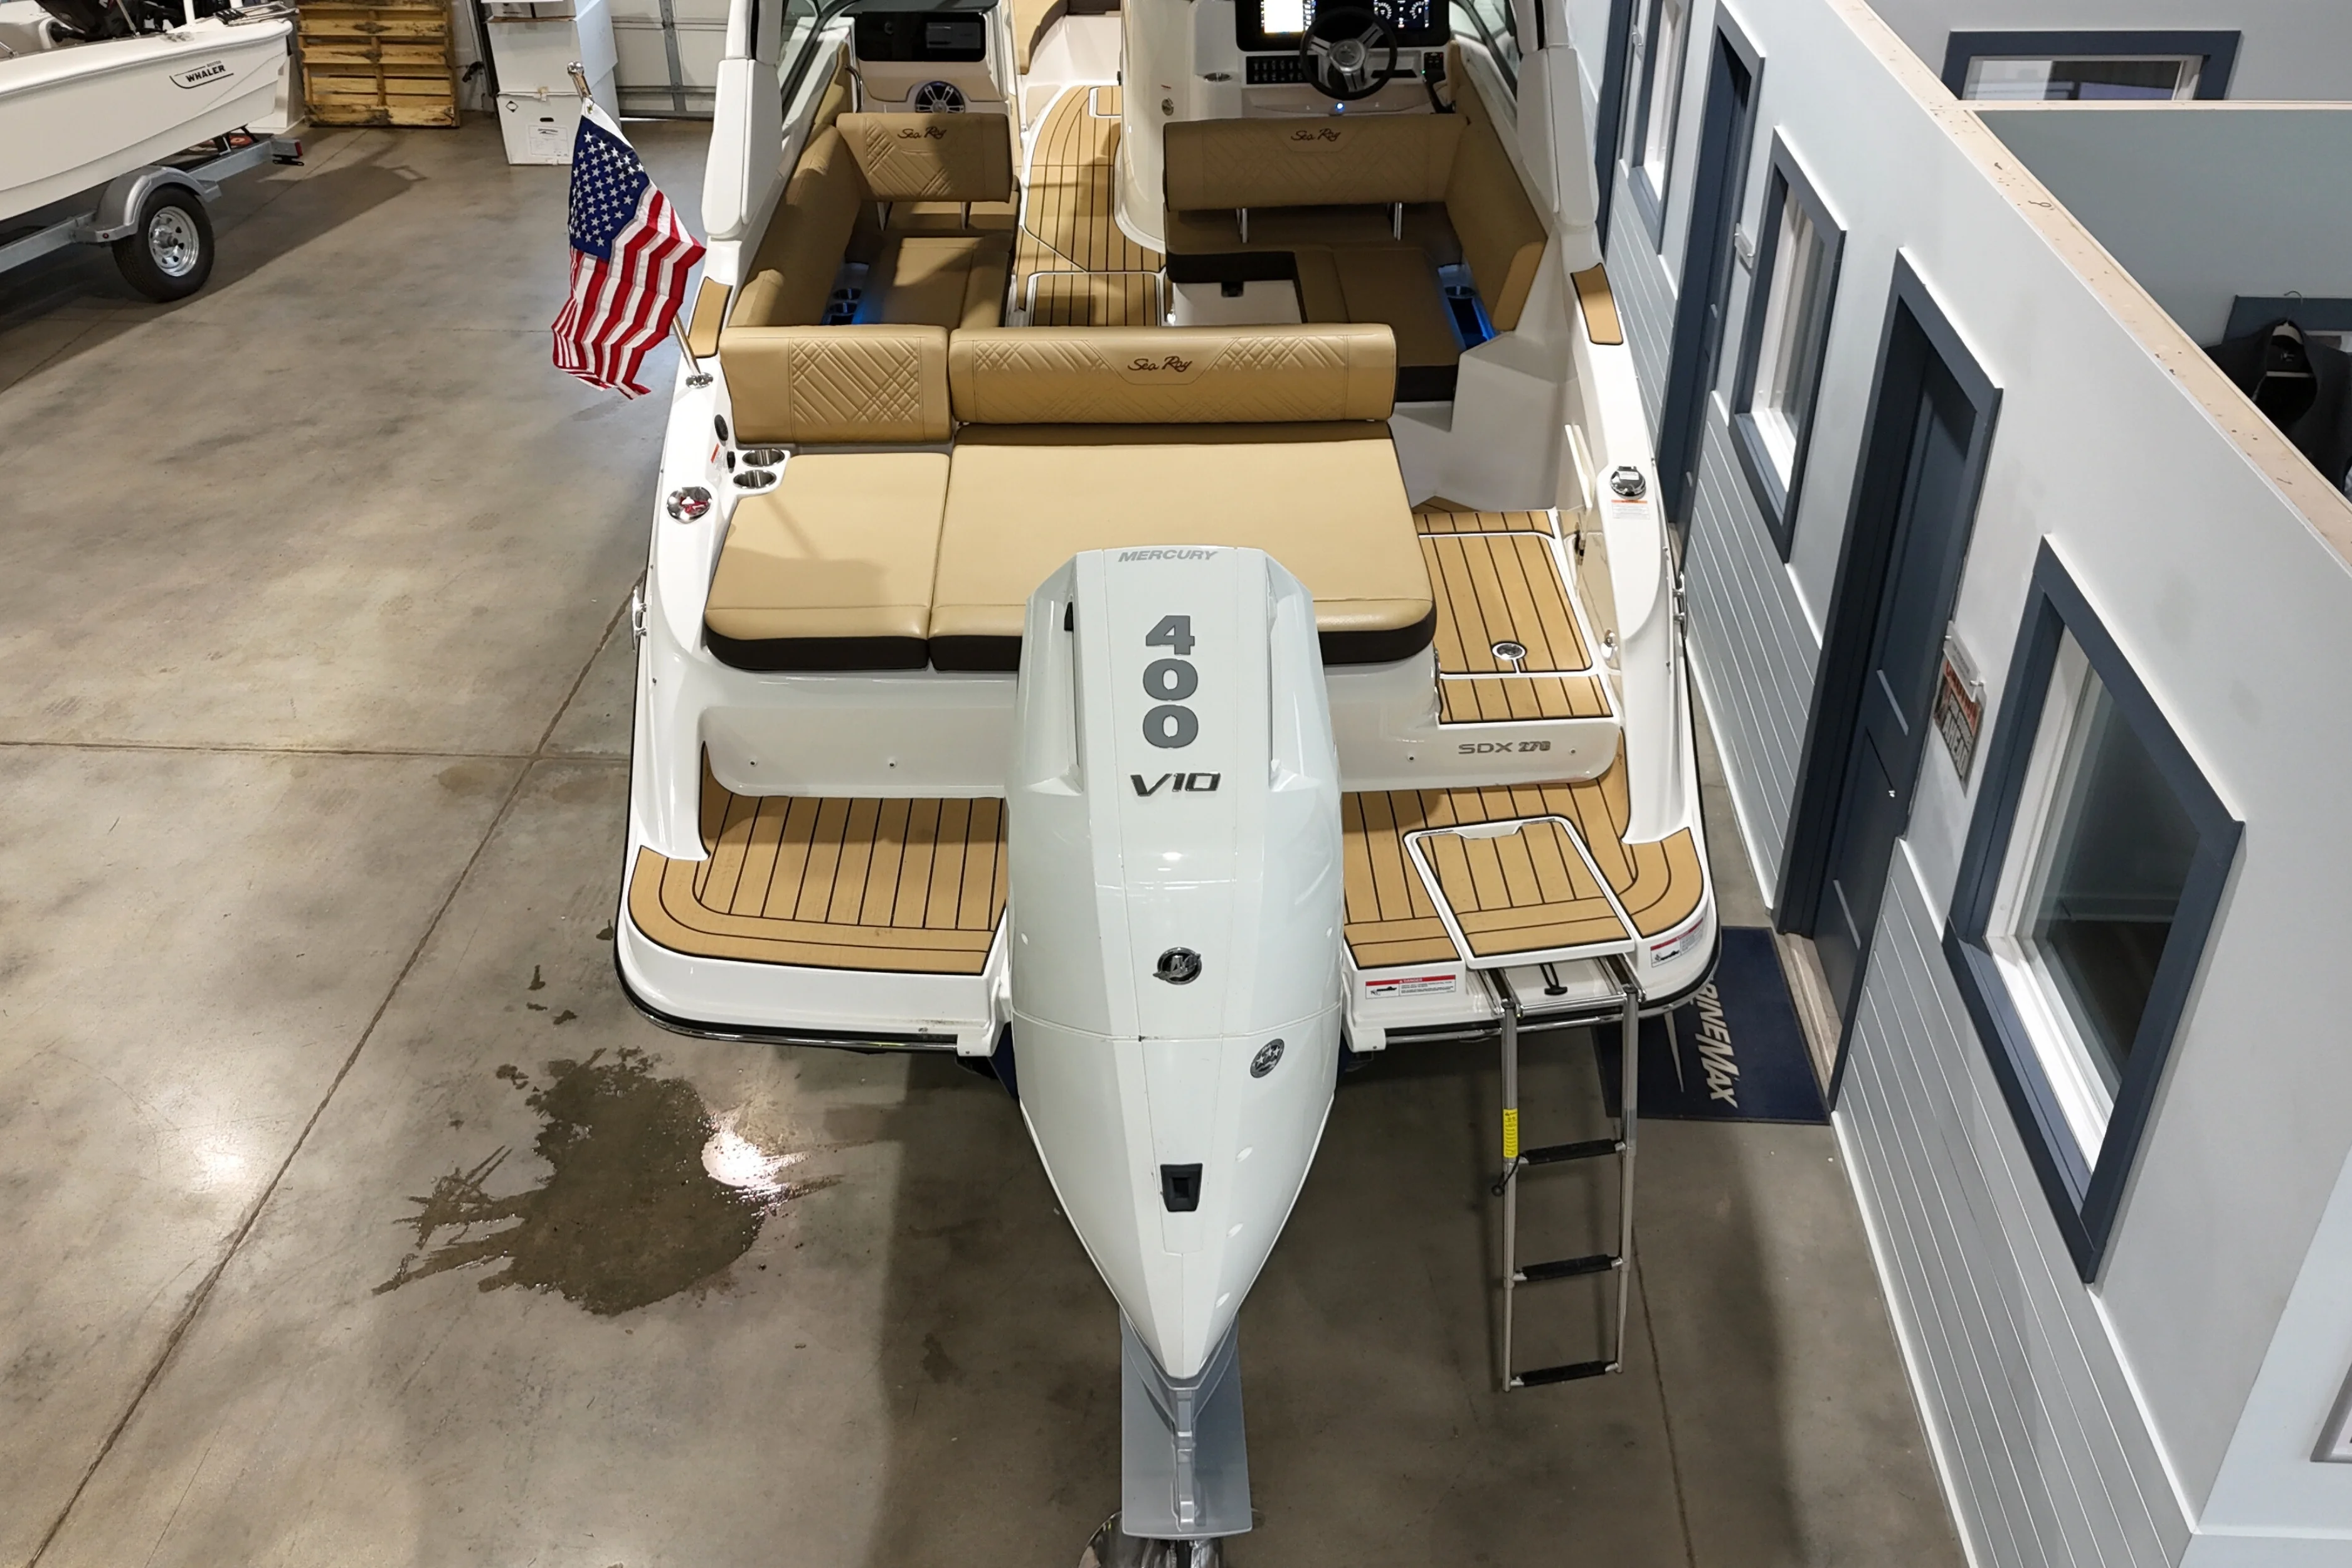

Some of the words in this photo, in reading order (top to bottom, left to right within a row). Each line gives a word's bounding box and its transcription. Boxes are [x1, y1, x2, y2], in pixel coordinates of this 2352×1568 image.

[186, 65, 226, 82] WHALER
[897, 128, 922, 139] Sea
[1290, 130, 1315, 141] Sea
[1317, 128, 1342, 142] Ray
[1127, 358, 1160, 371] Sea
[1161, 356, 1193, 373] Ray
[1118, 549, 1219, 562] MERCURY
[1143, 615, 1199, 748] 400
[1458, 743, 1513, 754] SDX
[1130, 773, 1221, 797] V10
